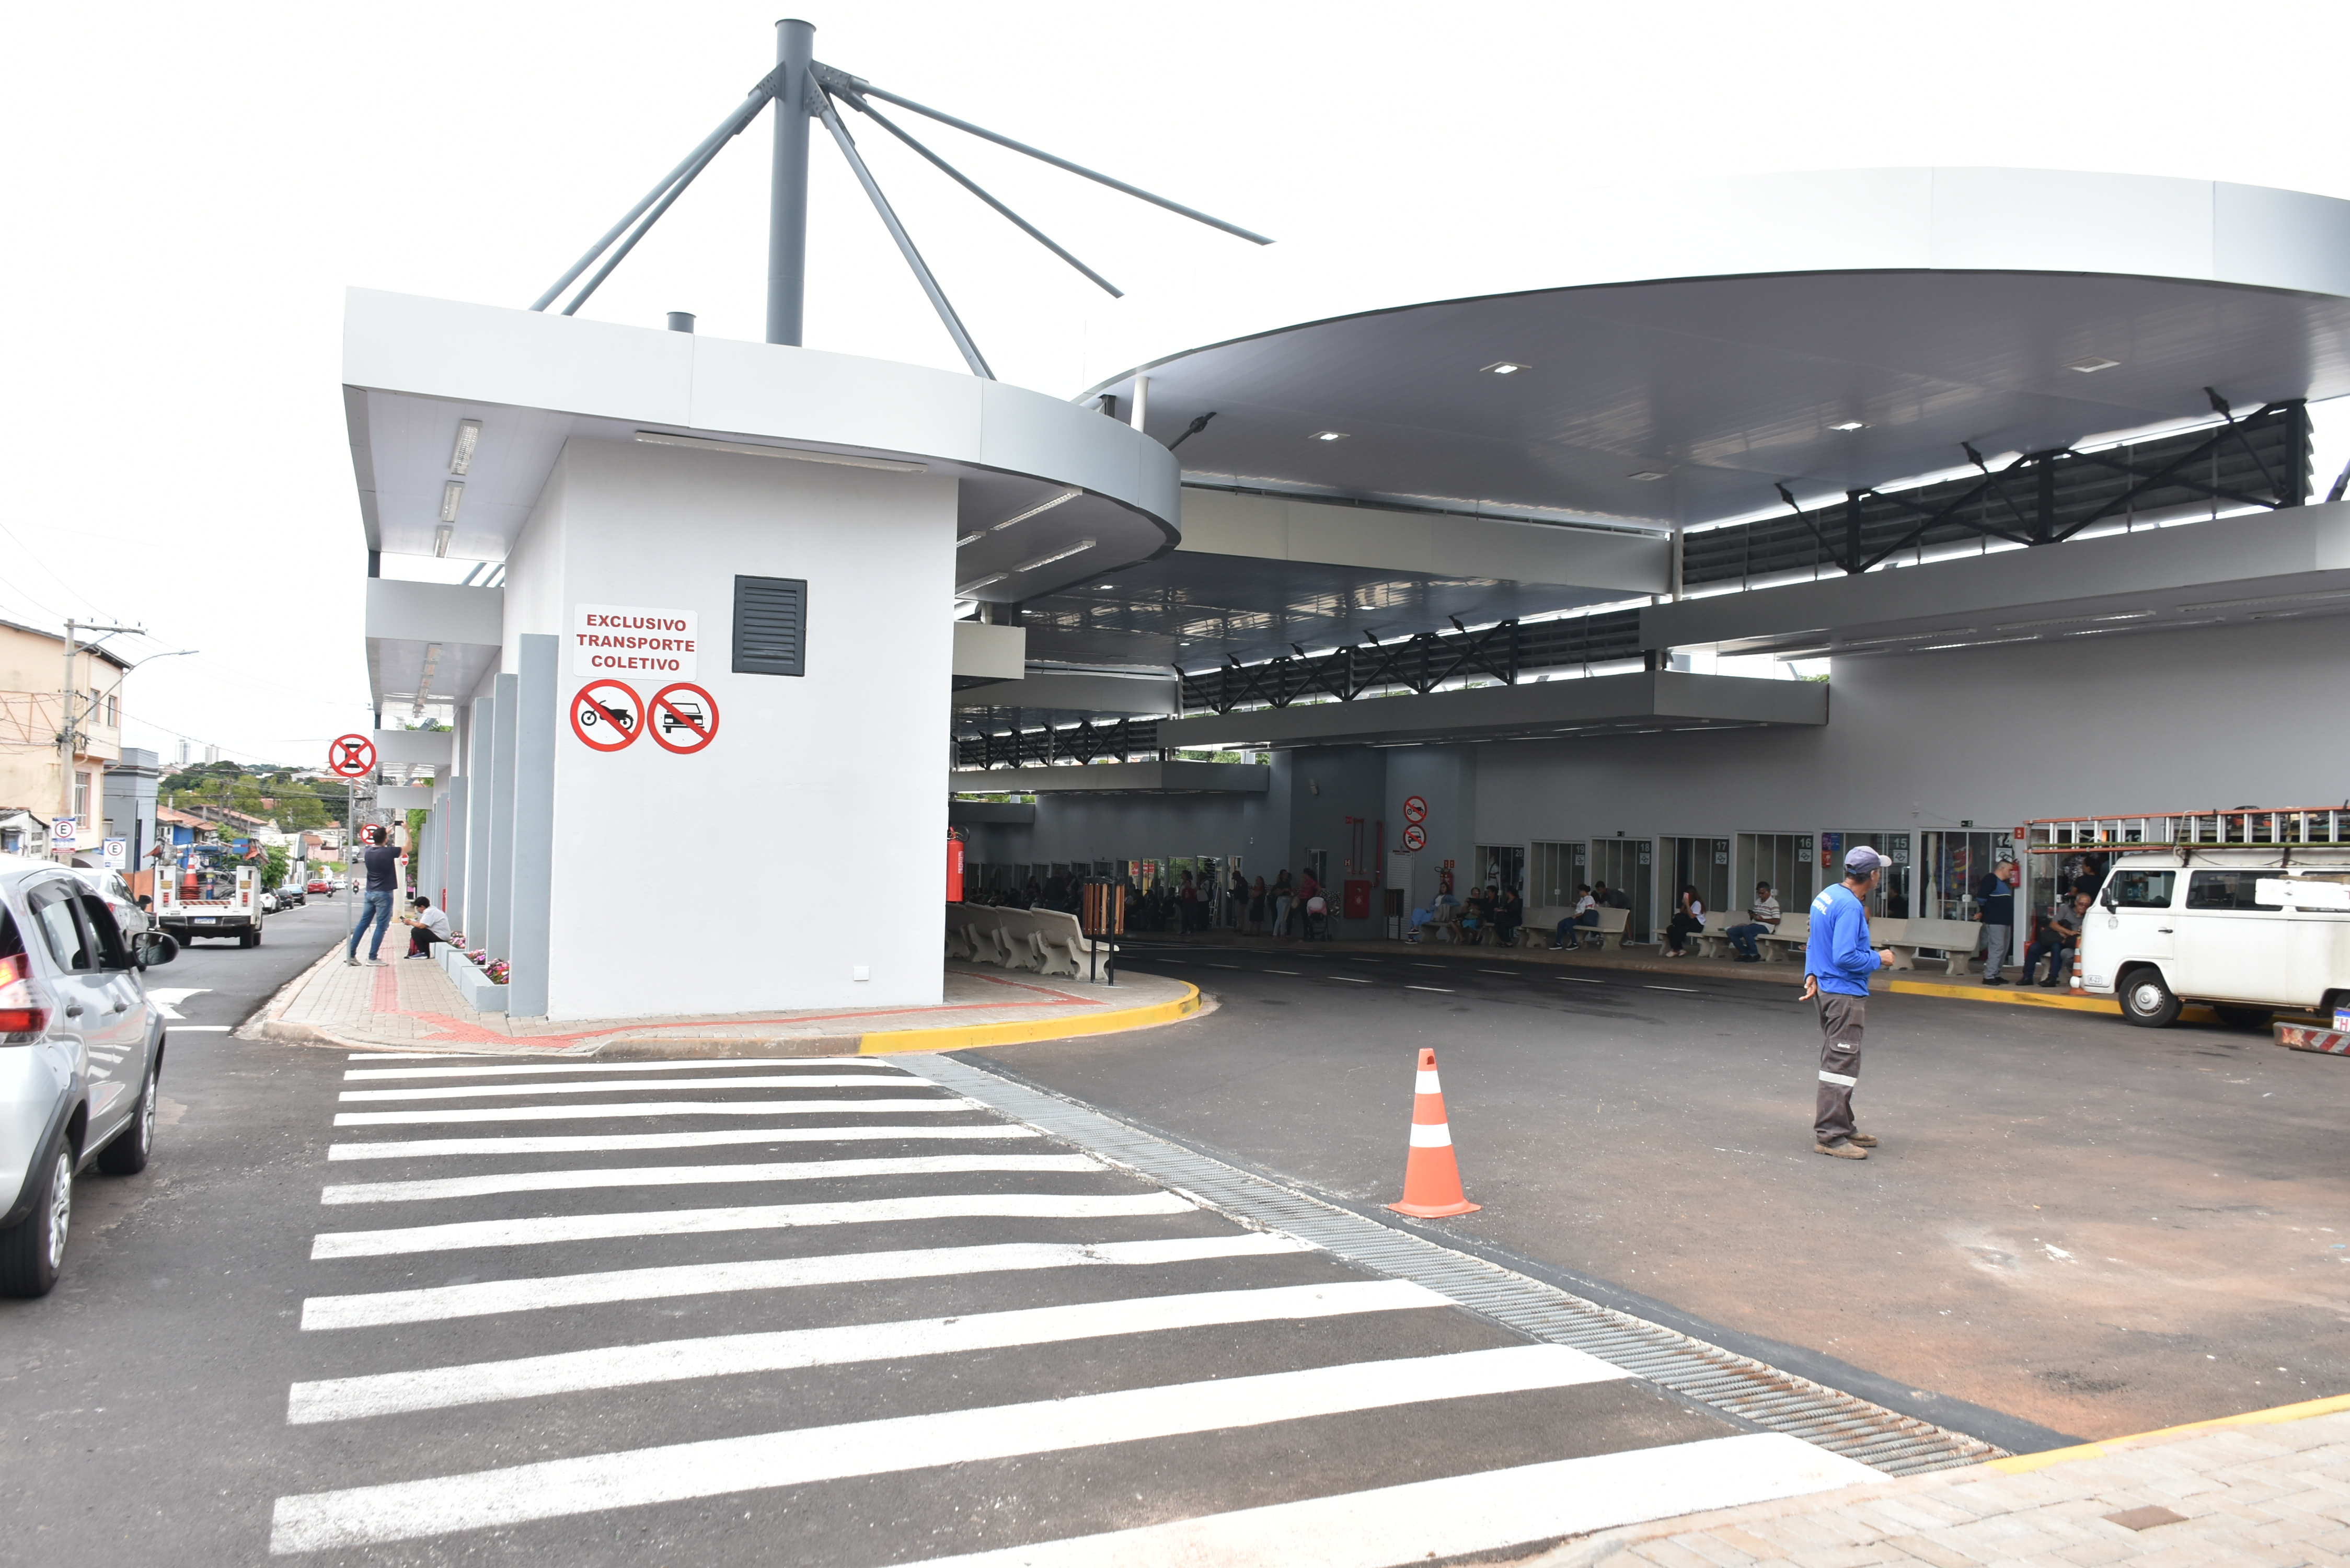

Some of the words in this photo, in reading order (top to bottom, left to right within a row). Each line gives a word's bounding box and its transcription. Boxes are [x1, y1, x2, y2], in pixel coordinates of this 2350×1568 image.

[586, 614, 686, 632] EXCLUSIVO
[576, 633, 695, 652] TRANSPORTE
[591, 655, 680, 672] COLETIVO
[60, 825, 67, 834] E
[1716, 841, 1727, 851] 17
[1800, 838, 1812, 848] 16
[1894, 837, 1907, 848] 15
[1997, 835, 2012, 847] 14
[112, 845, 118, 853] E
[1576, 845, 1585, 854] 19
[1640, 843, 1650, 852] 18
[1515, 849, 1524, 857] 20
[2340, 1018, 2350, 1032] H
